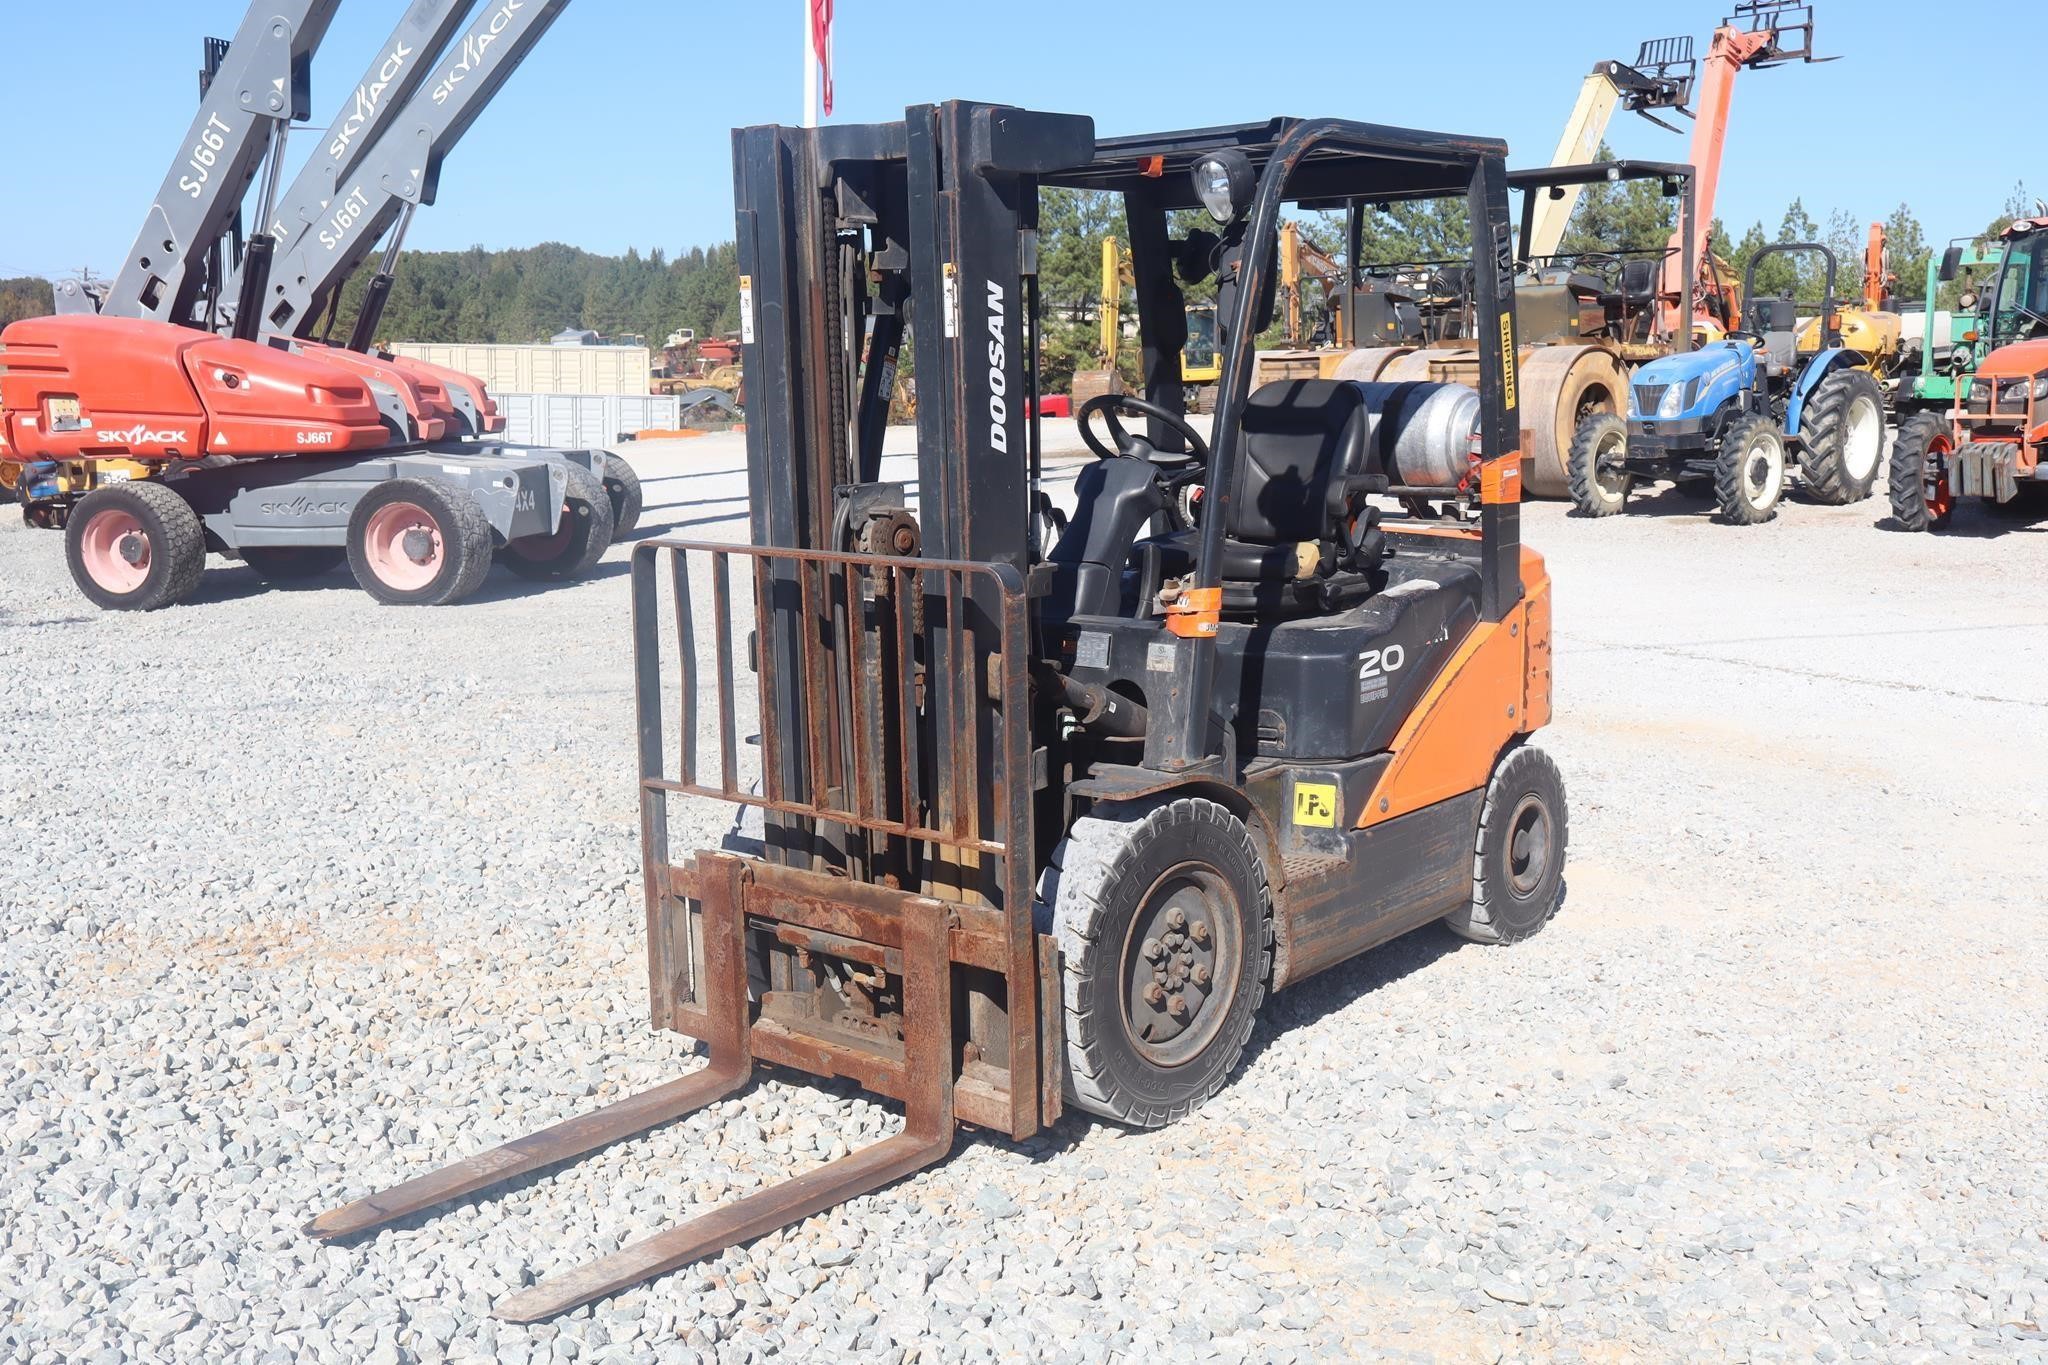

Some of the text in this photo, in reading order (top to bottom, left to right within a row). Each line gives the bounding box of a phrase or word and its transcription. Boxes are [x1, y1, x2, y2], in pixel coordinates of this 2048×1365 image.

[431, 0, 524, 106] SKYJACK
[329, 40, 413, 160] SKYJACK
[179, 111, 231, 198] SJ66T
[319, 186, 369, 250] SJ66T
[987, 279, 1007, 453] DOOSAN
[1502, 319, 1513, 401] SHIPPING
[96, 424, 188, 445] SKYJACK
[296, 431, 333, 444] SJ66T
[260, 496, 350, 517] SKYJACK
[1359, 644, 1405, 680] 20
